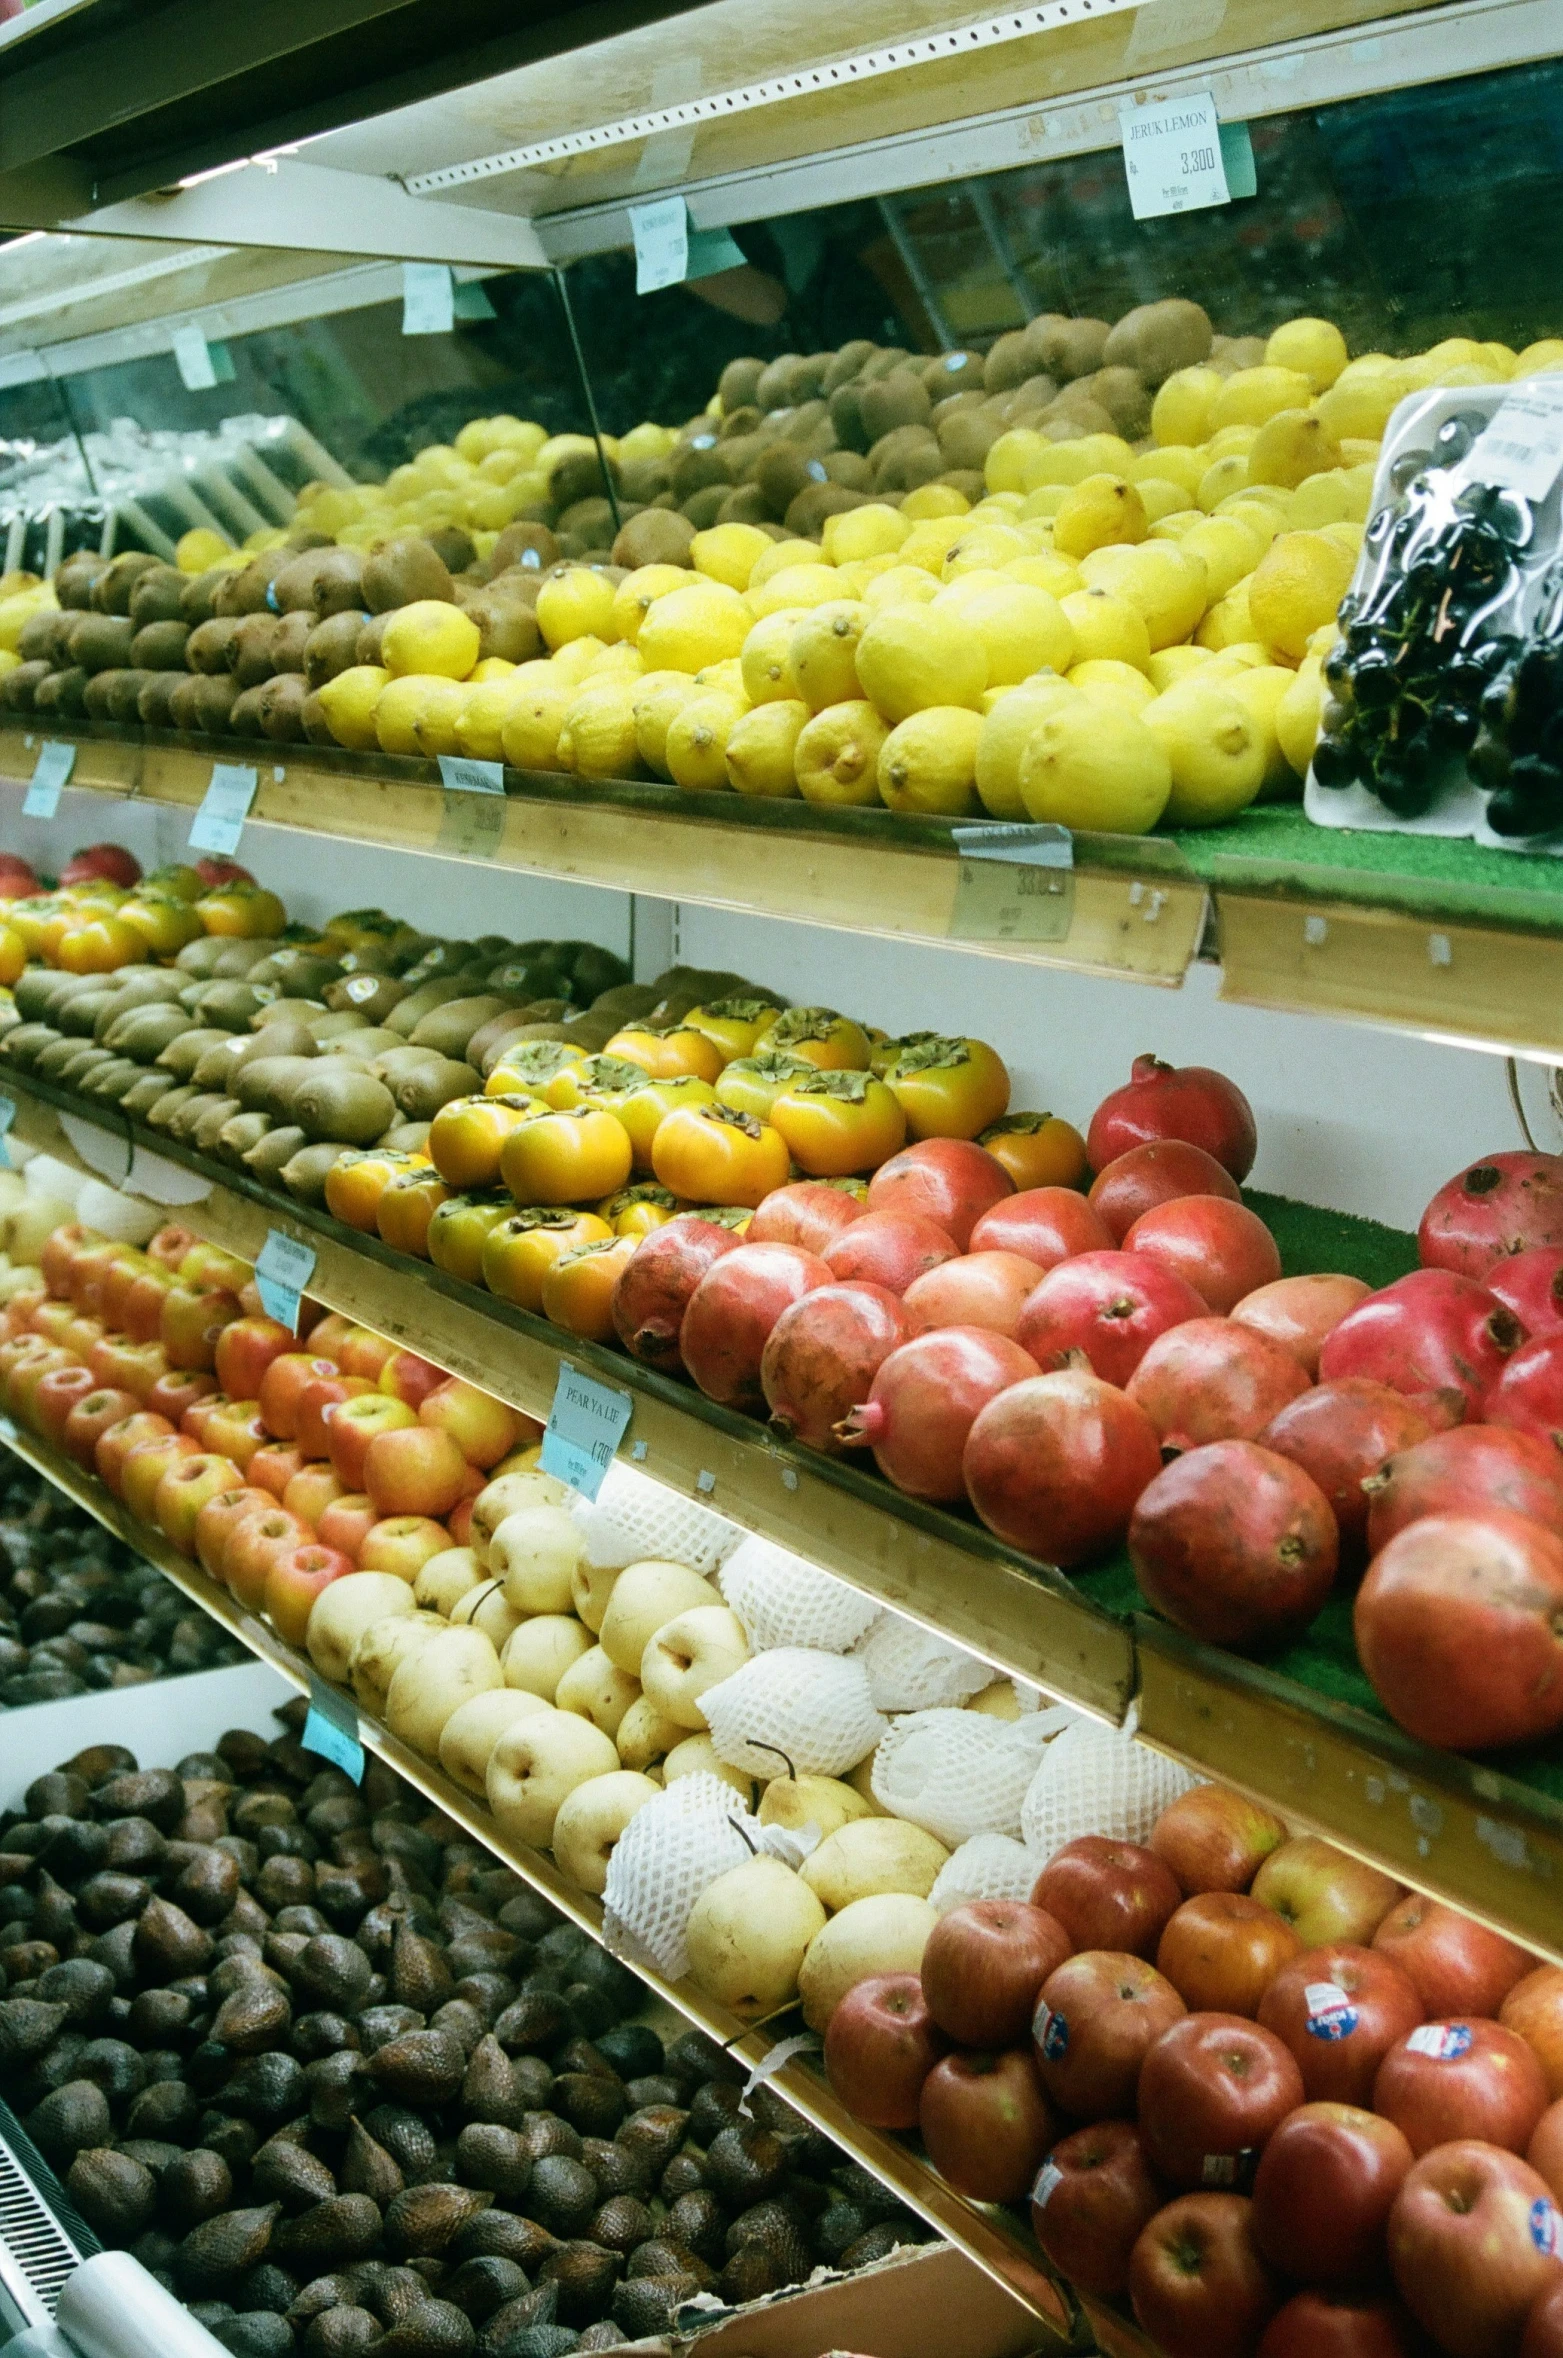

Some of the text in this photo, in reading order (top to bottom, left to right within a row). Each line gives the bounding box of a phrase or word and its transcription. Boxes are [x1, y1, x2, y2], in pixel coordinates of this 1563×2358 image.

[1130, 110, 1208, 141] JERUK LEMON
[1180, 147, 1215, 175] 3,300
[565, 1386, 590, 1410] PEAR
